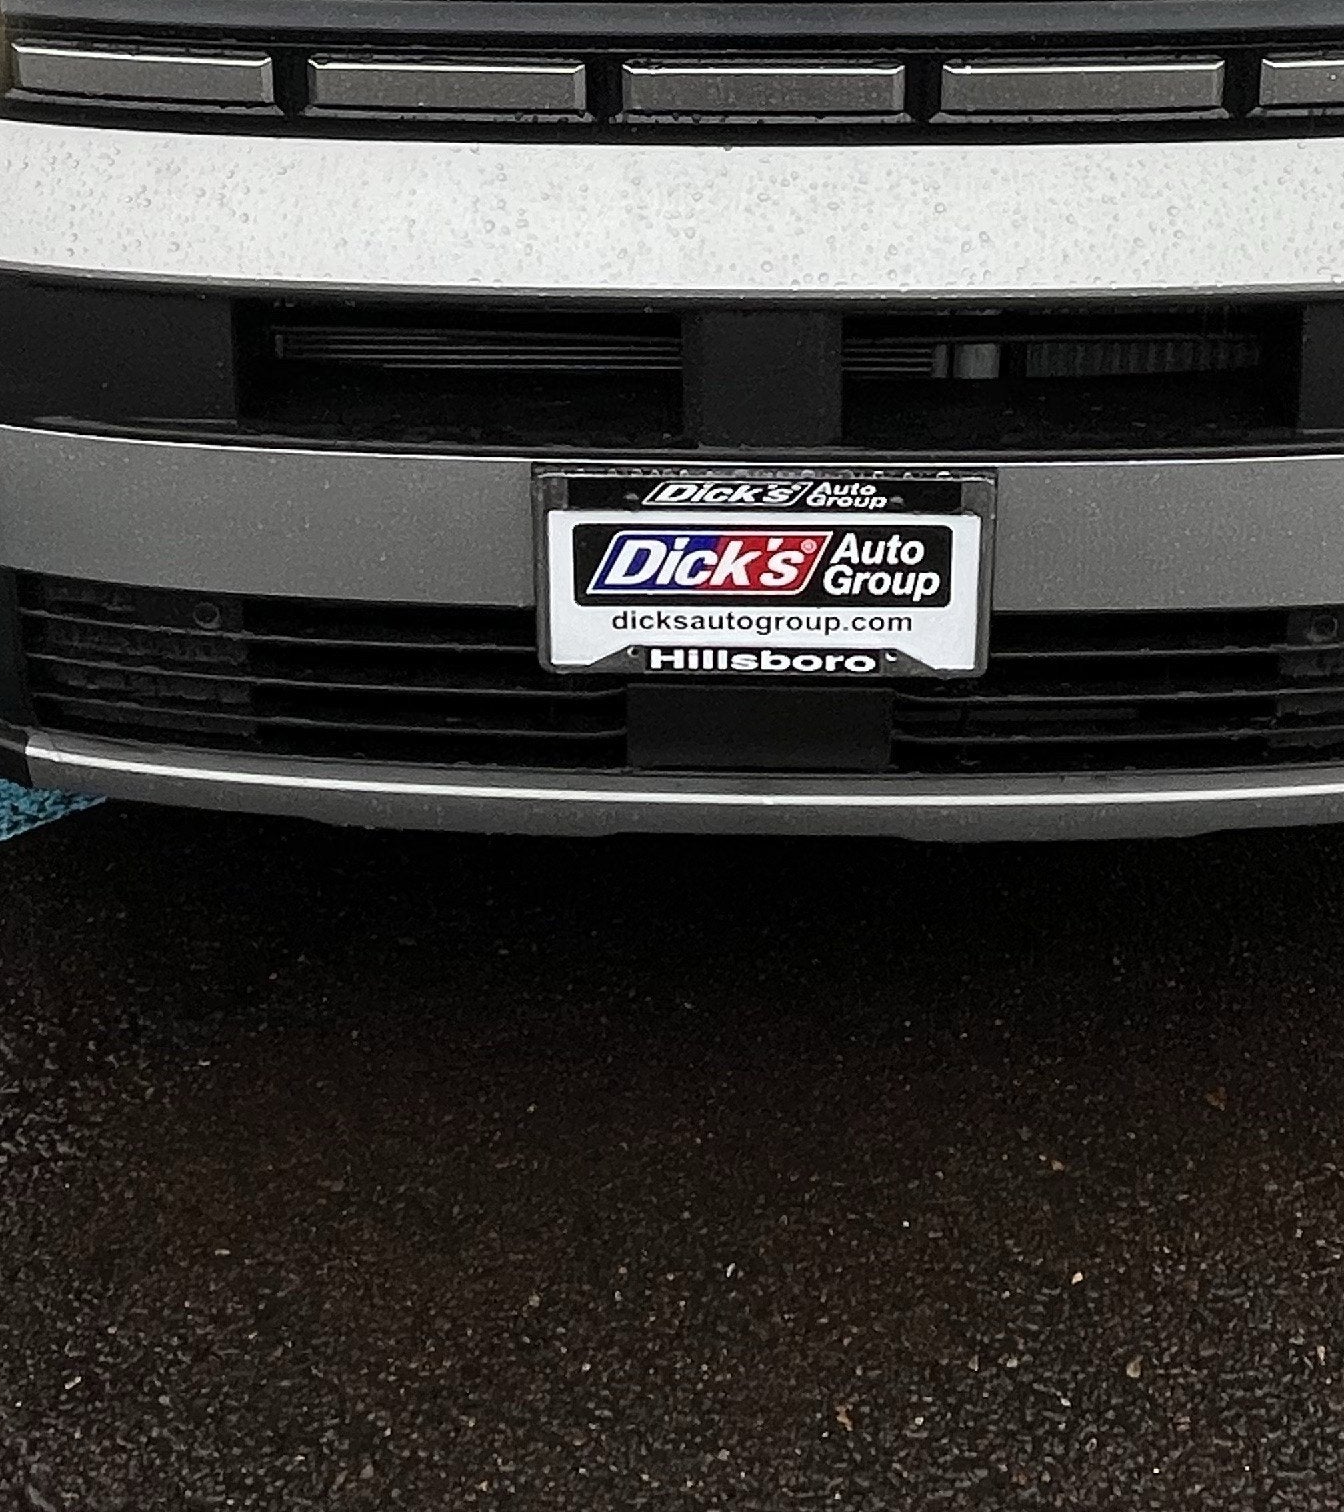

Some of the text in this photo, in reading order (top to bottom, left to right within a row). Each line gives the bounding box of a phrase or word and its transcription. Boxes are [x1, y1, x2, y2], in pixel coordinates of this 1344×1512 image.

[657, 482, 795, 505] Dick's
[814, 482, 877, 496] Auto
[807, 494, 887, 510] Group
[830, 533, 925, 565] Auto
[603, 537, 806, 587] Dick's
[823, 564, 941, 602] Group
[612, 610, 913, 635] dicksautogroup.com
[651, 648, 876, 672] Hillsboro
